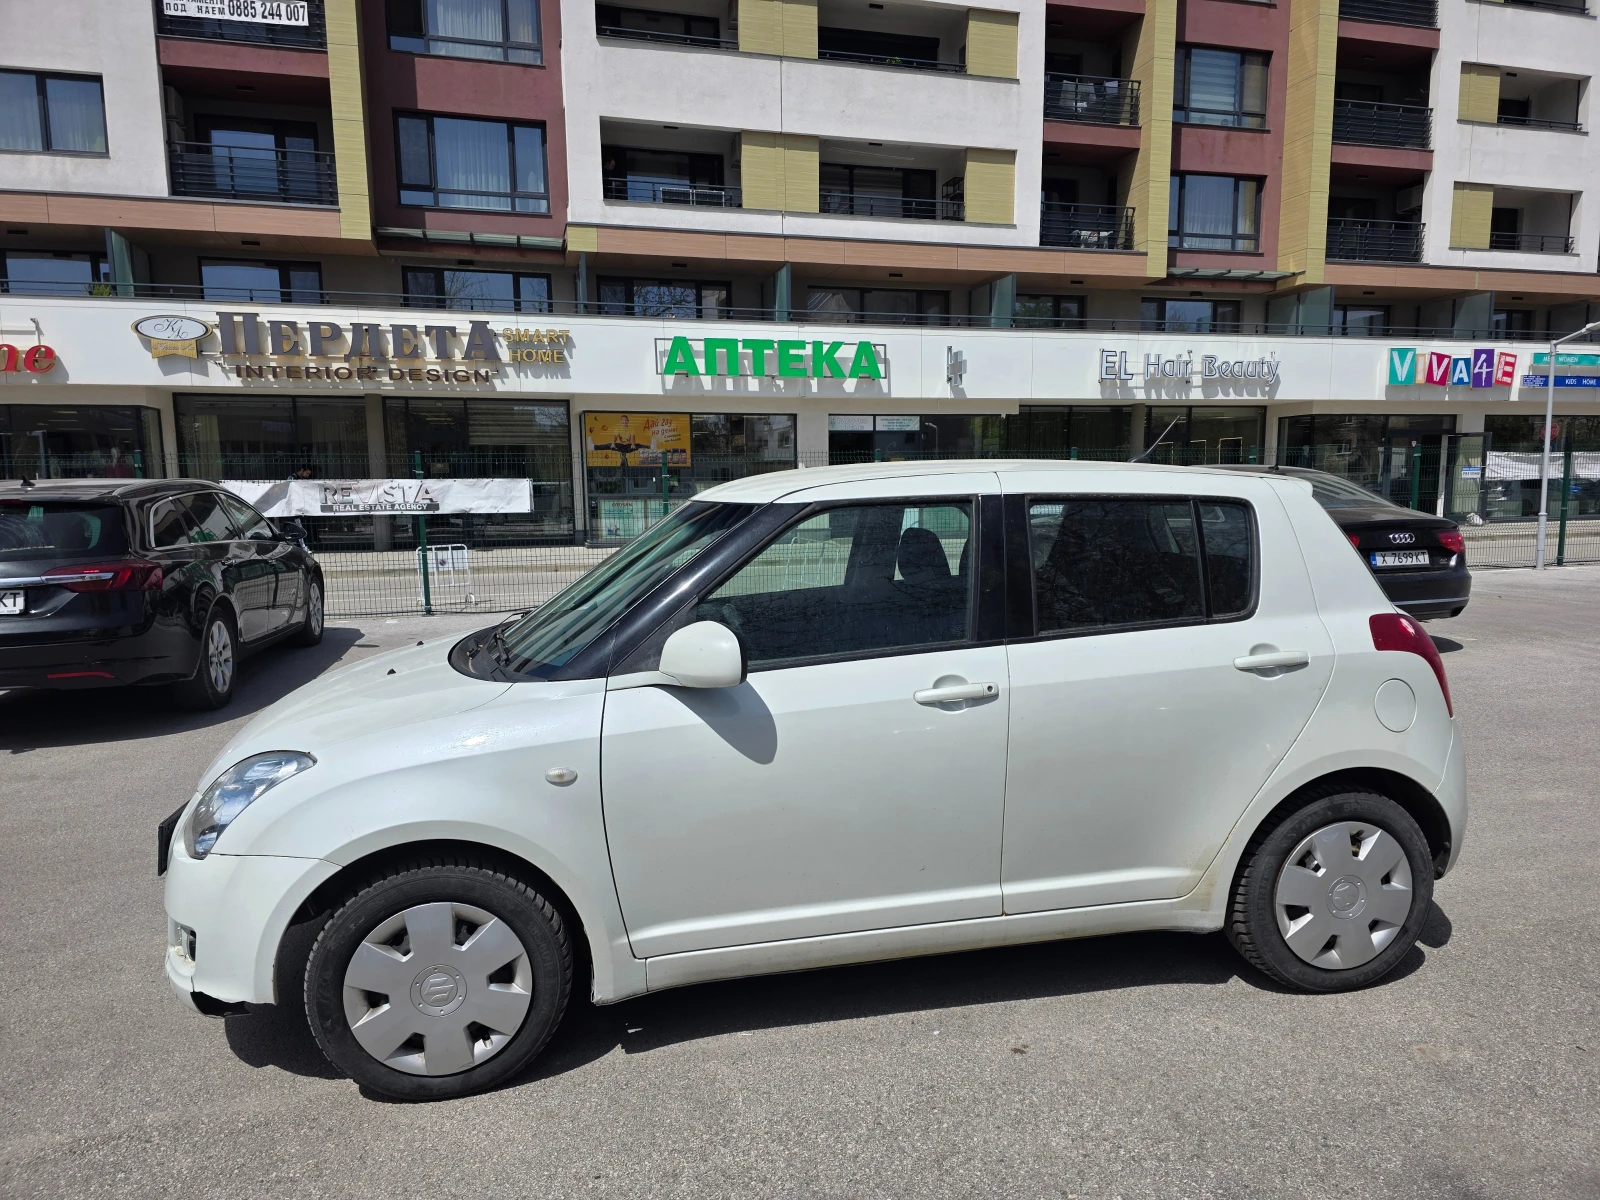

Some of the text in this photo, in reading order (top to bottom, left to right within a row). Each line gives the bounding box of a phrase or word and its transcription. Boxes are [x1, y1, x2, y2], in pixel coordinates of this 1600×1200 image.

[165, 2, 187, 13] ПОД
[197, 5, 226, 15] НАЕМ
[228, 1, 306, 22] 0885 244 007
[215, 311, 501, 362] ПЕРДЕТА
[503, 328, 570, 344] SMART
[508, 348, 566, 364] HOME
[663, 335, 883, 379] АПТЕКА
[235, 364, 490, 384] INTERIOR DESIGN
[1100, 350, 1281, 384] EL Hair Beauty
[1582, 378, 1597, 386] HOME
[319, 481, 440, 505] REVISTA
[333, 503, 428, 512] REAL ESTATE AGENCY
[1381, 553, 1388, 564] X
